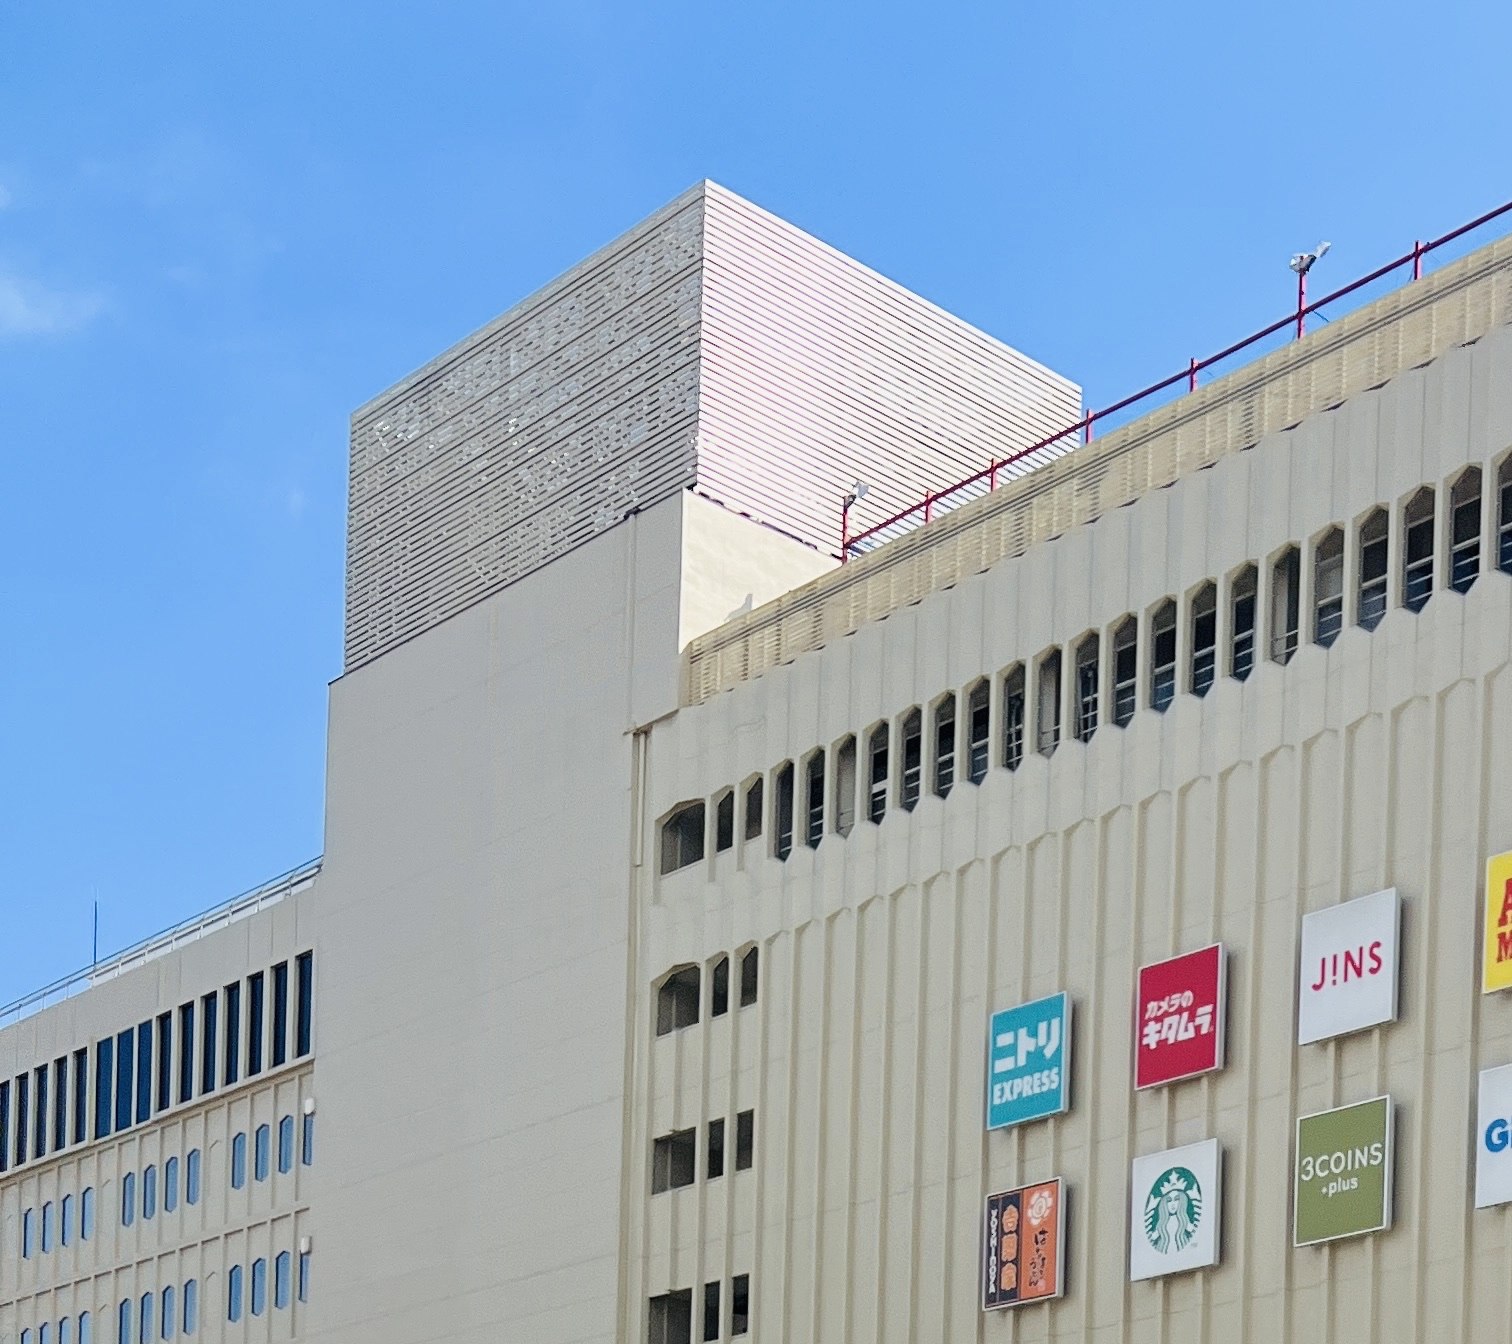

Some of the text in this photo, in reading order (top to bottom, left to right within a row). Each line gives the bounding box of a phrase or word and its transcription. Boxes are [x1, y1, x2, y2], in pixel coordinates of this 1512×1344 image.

[1144, 990, 1194, 1020] カメラの
[994, 1017, 1060, 1074] ニトリ
[1142, 1004, 1214, 1050] キタムラ
[993, 1067, 1060, 1105] EXPRESS
[1301, 1143, 1384, 1181] 3COINS
